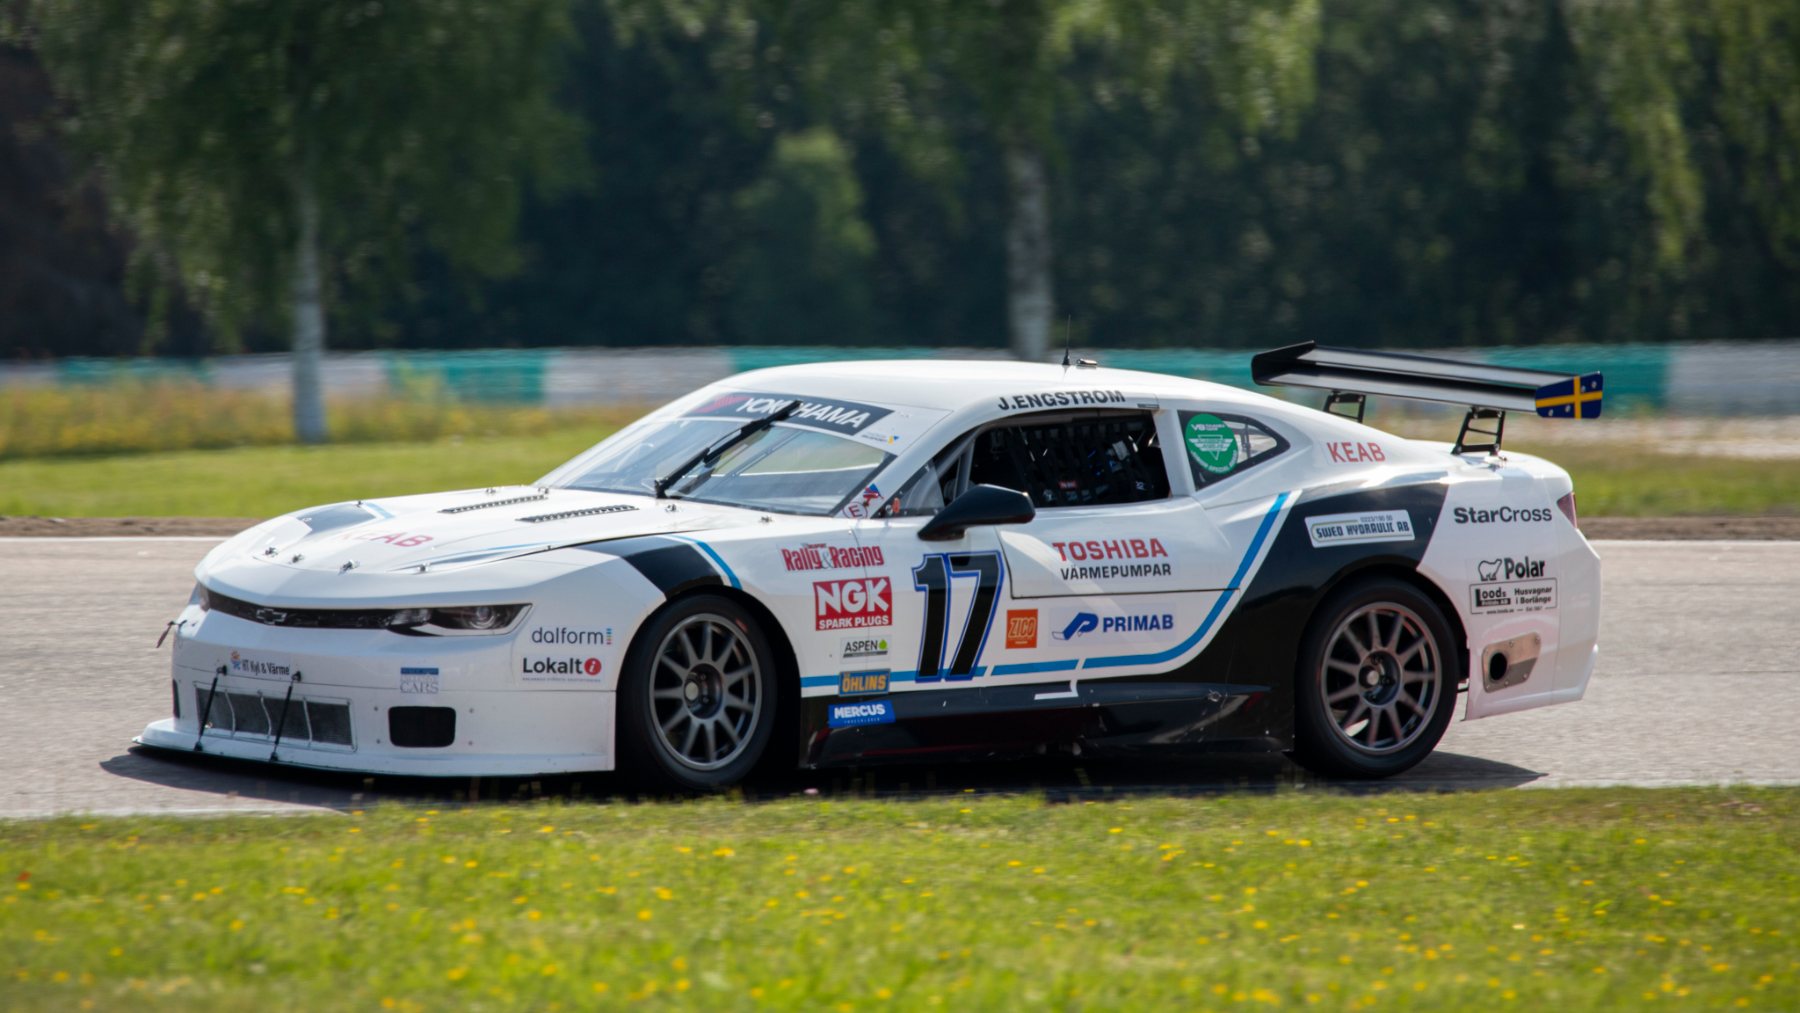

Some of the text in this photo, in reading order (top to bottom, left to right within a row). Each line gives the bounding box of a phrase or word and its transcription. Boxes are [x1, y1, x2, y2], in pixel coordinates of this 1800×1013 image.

[735, 397, 872, 428] YOKHAMA
[1326, 442, 1386, 463] KEAB
[848, 504, 863, 517] E
[1453, 506, 1553, 524] StarCross
[1346, 522, 1395, 536] HYDRAULIC
[1396, 520, 1410, 532] AB
[1052, 538, 1168, 562] TOSHIBA
[1060, 563, 1172, 581] VÄRMEPUMPAR
[1504, 556, 1545, 580] Polar
[816, 578, 889, 616] NGK
[1514, 586, 1553, 597] Husvagnar
[818, 616, 889, 630] SPARK PLUGS
[911, 550, 1005, 684] 17
[1103, 614, 1174, 633] PRIMAB
[531, 626, 604, 645] dalform
[1008, 616, 1036, 639] ZICO
[845, 640, 878, 652] ASPEN
[260, 662, 267, 674] &
[266, 662, 290, 676] Värme
[523, 657, 583, 674] Lokalt
[400, 681, 439, 694] CARS
[834, 703, 886, 719] MERCUS
